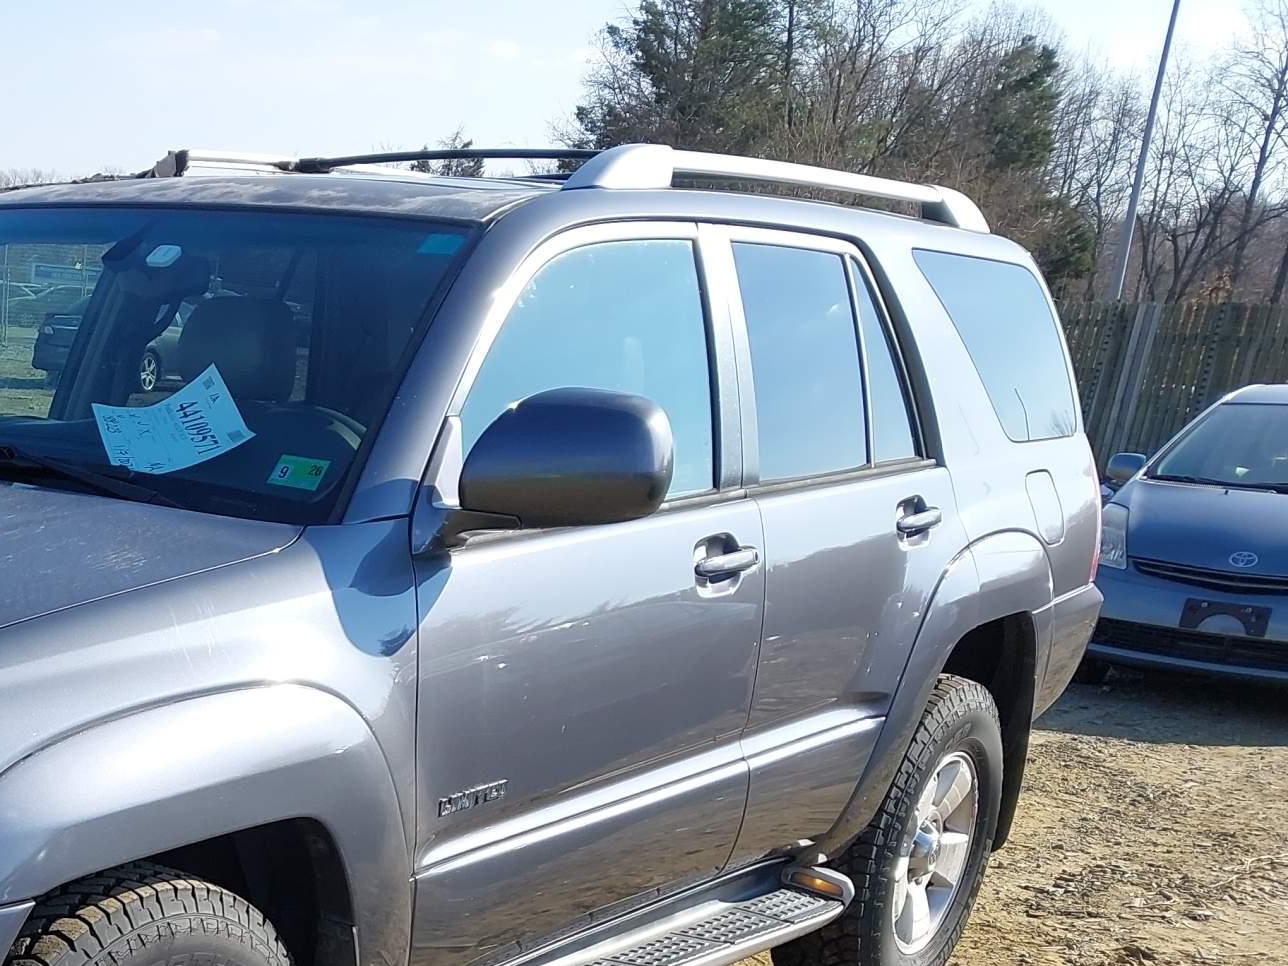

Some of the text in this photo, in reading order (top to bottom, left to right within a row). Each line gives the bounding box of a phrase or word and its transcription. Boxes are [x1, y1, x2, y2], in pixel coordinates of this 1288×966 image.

[175, 400, 223, 455] 44109571
[278, 464, 325, 479] 9 26
